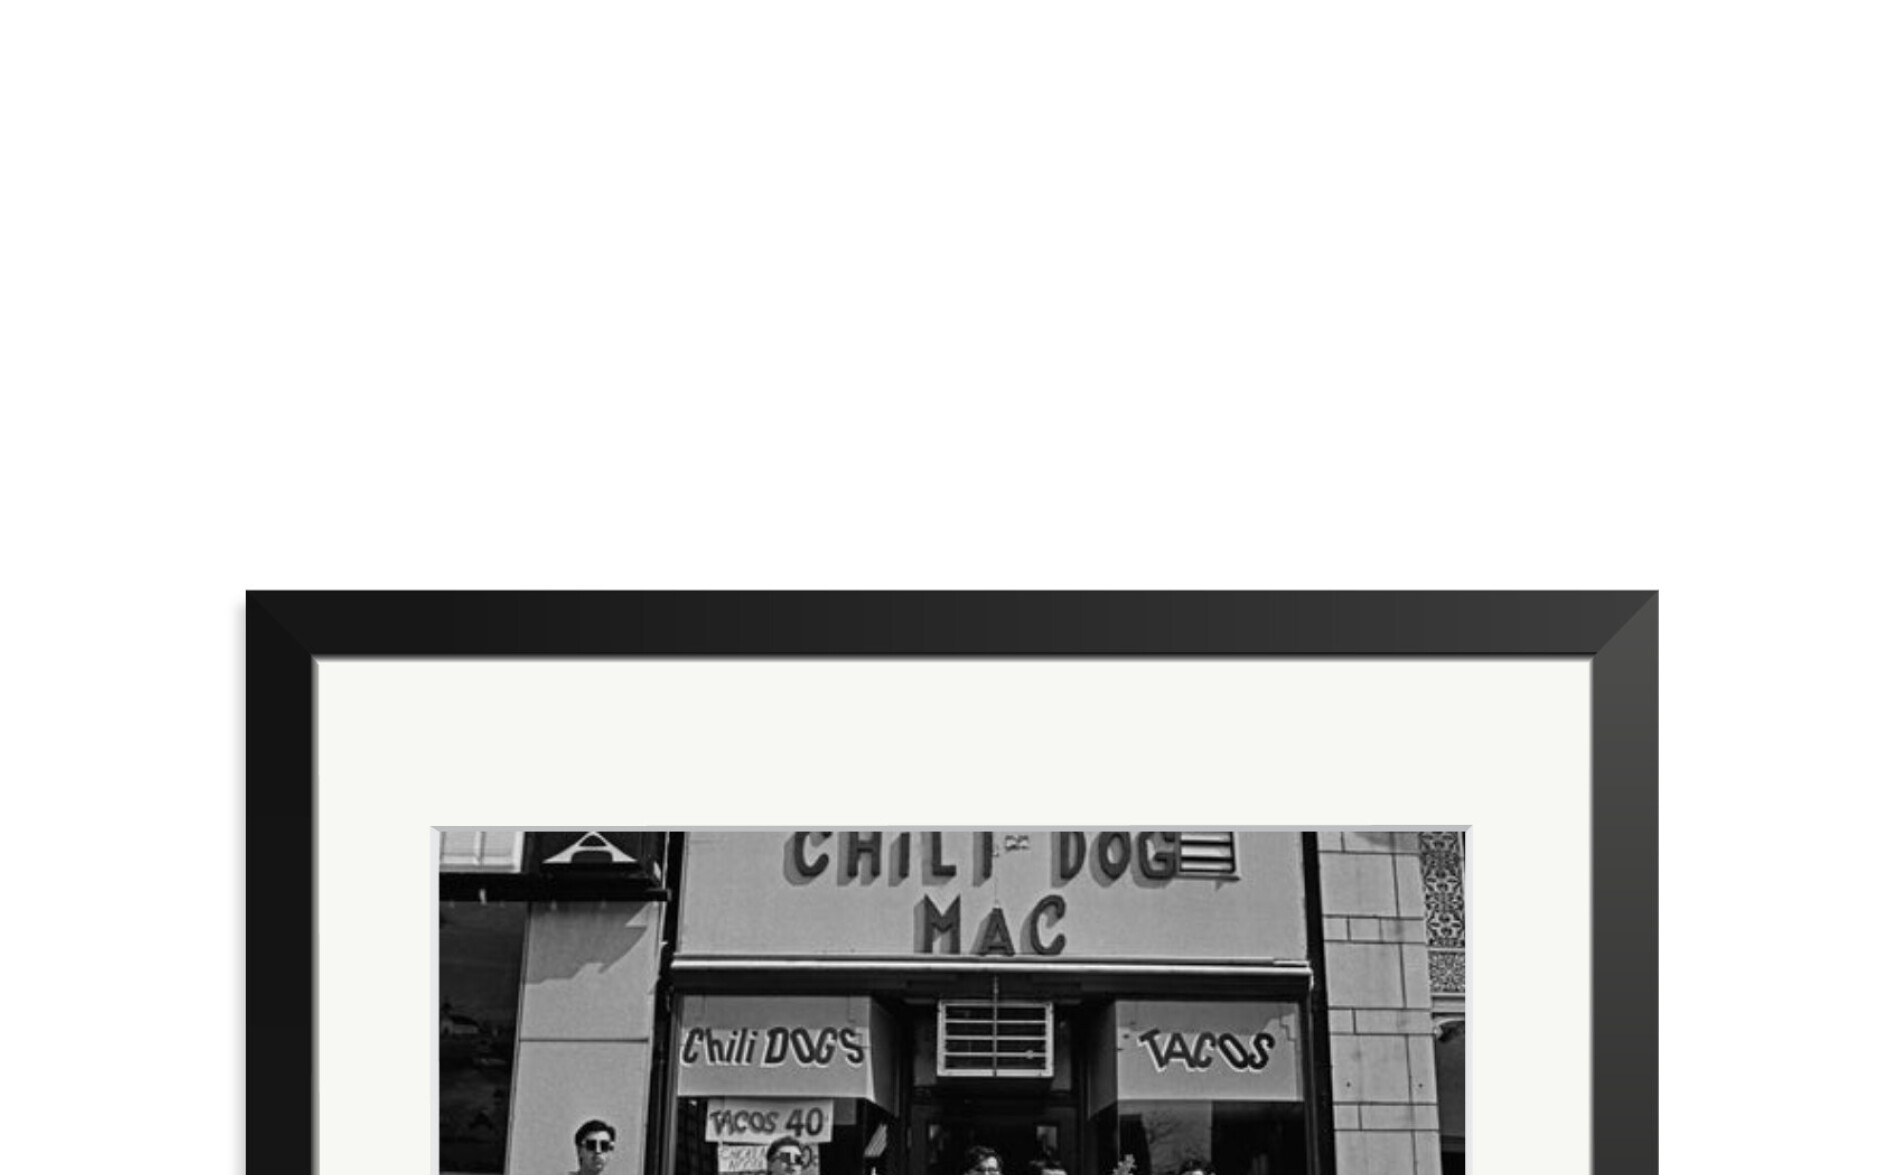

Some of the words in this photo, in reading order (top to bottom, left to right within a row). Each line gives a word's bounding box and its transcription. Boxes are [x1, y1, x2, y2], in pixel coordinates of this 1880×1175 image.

[784, 832, 993, 887] CHILI
[1051, 832, 1177, 889] DOG
[913, 893, 1067, 956] MAC
[680, 1026, 758, 1067] Chili
[761, 1026, 865, 1068] DOGS
[1137, 1027, 1276, 1072] TACOS
[709, 1109, 780, 1136] TACOS
[785, 1107, 824, 1137] 40
